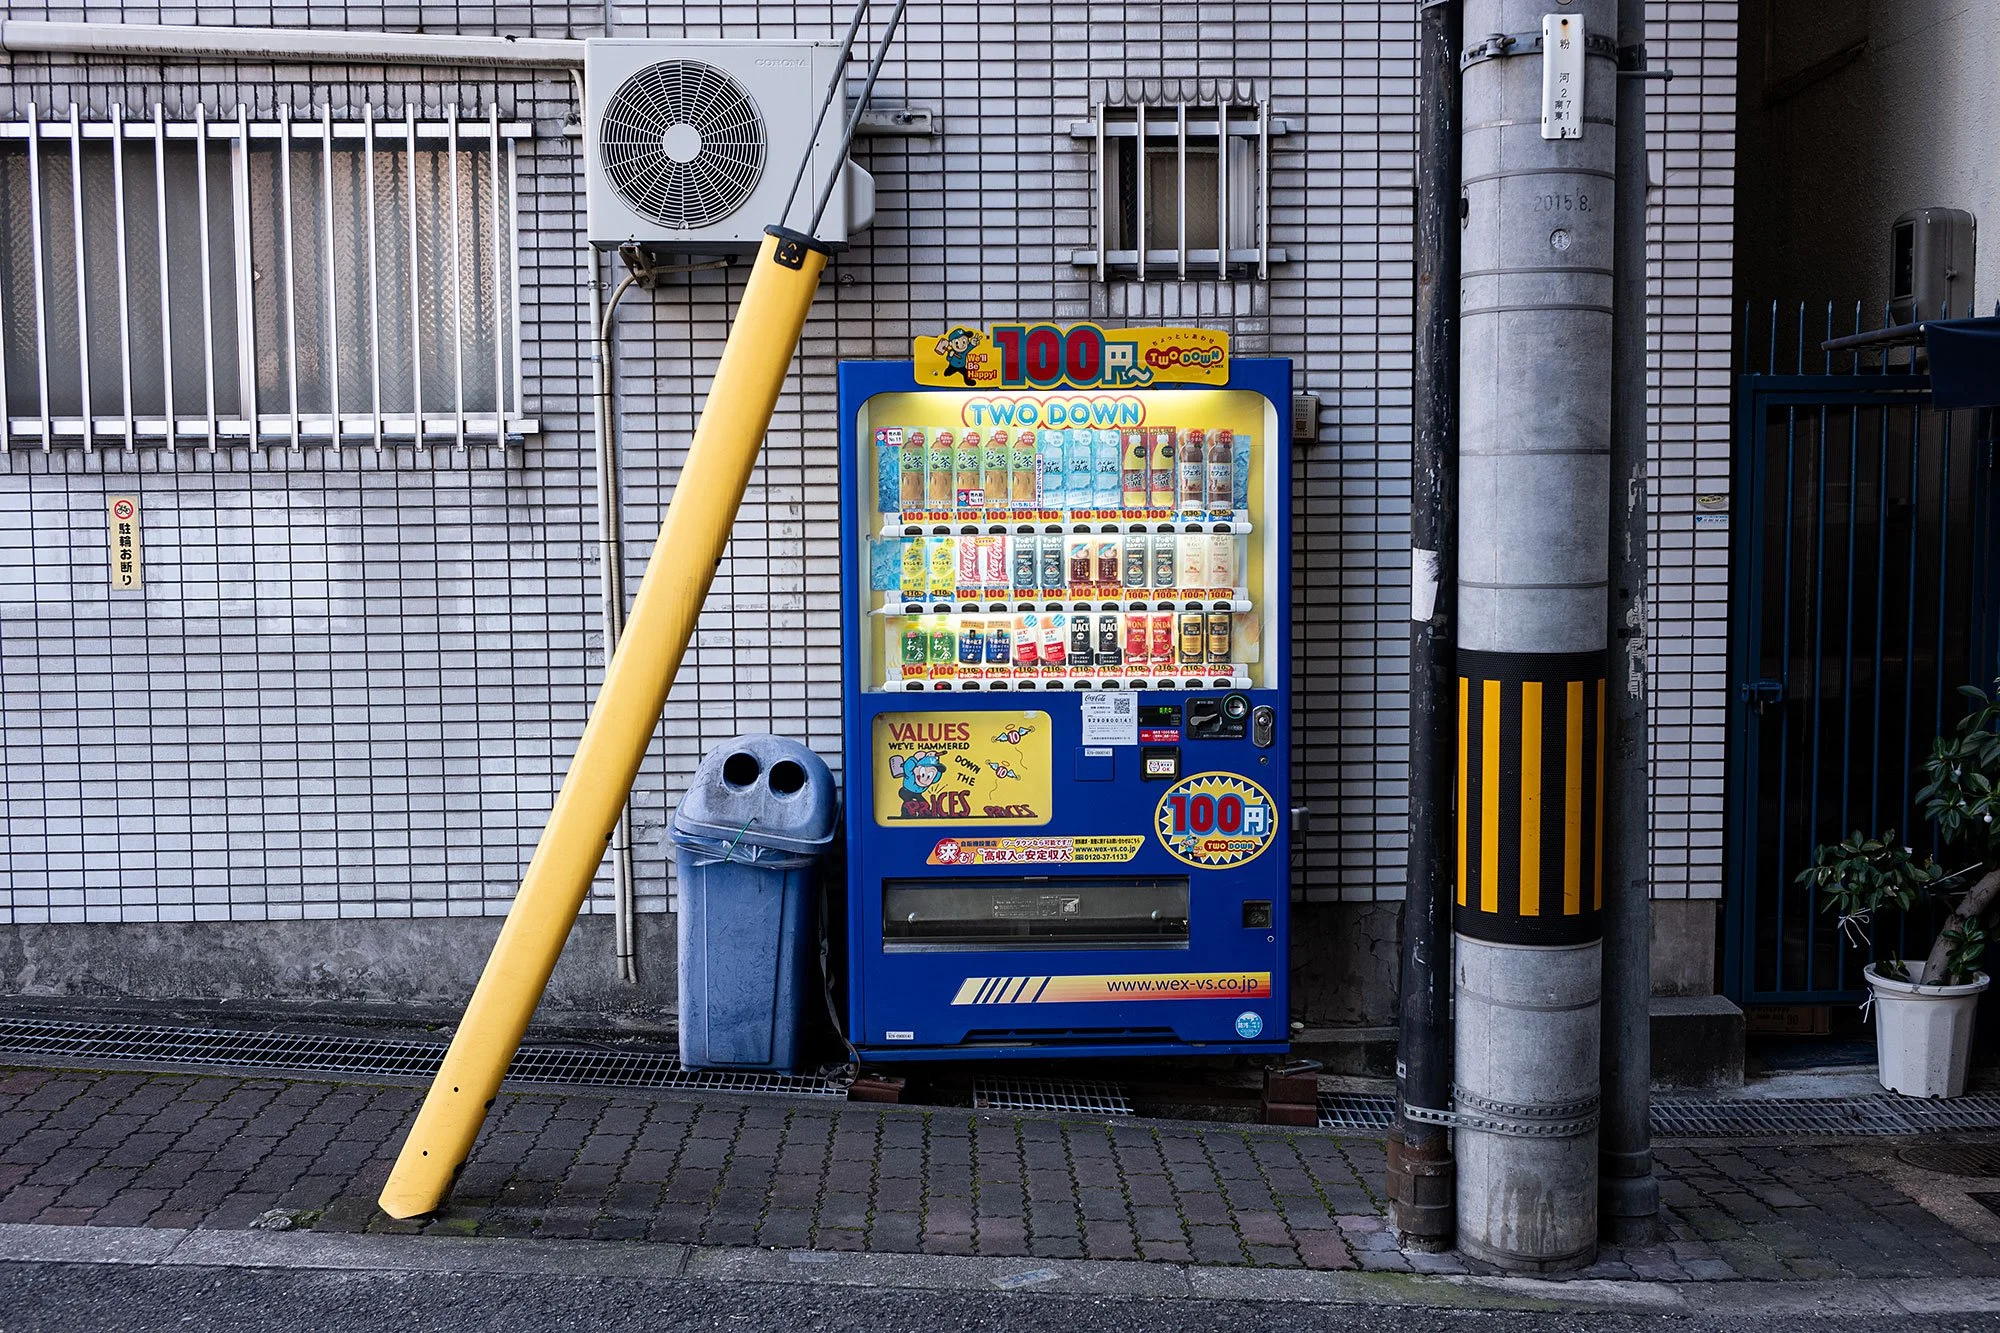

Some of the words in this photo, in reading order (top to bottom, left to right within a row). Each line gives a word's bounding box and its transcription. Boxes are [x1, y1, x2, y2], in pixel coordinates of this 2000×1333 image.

[755, 58, 808, 68] CORONA
[1152, 333, 1215, 346] ちょっとしあわせ
[967, 354, 987, 362] We'll
[1150, 351, 1179, 366] TWO
[1182, 350, 1220, 365] DOWN
[968, 362, 979, 370] Be
[967, 369, 998, 380] Happy!
[969, 403, 1038, 427] TWO
[1047, 402, 1140, 425] DOWN
[902, 452, 924, 468] お茶
[930, 452, 952, 468] お茶
[958, 452, 978, 468] お茶
[986, 451, 1006, 466] お茶
[1013, 452, 1034, 468] お茶
[118, 523, 132, 586] 駐輪お断り
[1072, 623, 1090, 632] BLACK
[888, 722, 970, 742] VALUES
[1008, 732, 1020, 744] 10
[888, 742, 915, 750] WE'VE
[918, 742, 970, 750] HAMMERED
[954, 755, 981, 774] DOWN
[997, 766, 1007, 777] 10
[957, 772, 976, 786] THE
[903, 790, 971, 817] PRICES
[1170, 795, 1265, 833] 100円
[1076, 845, 1136, 854] www.wex-vs.co.jp
[1228, 842, 1254, 850] DOWN
[1106, 976, 1258, 992] www.wex-vs.co.jp
